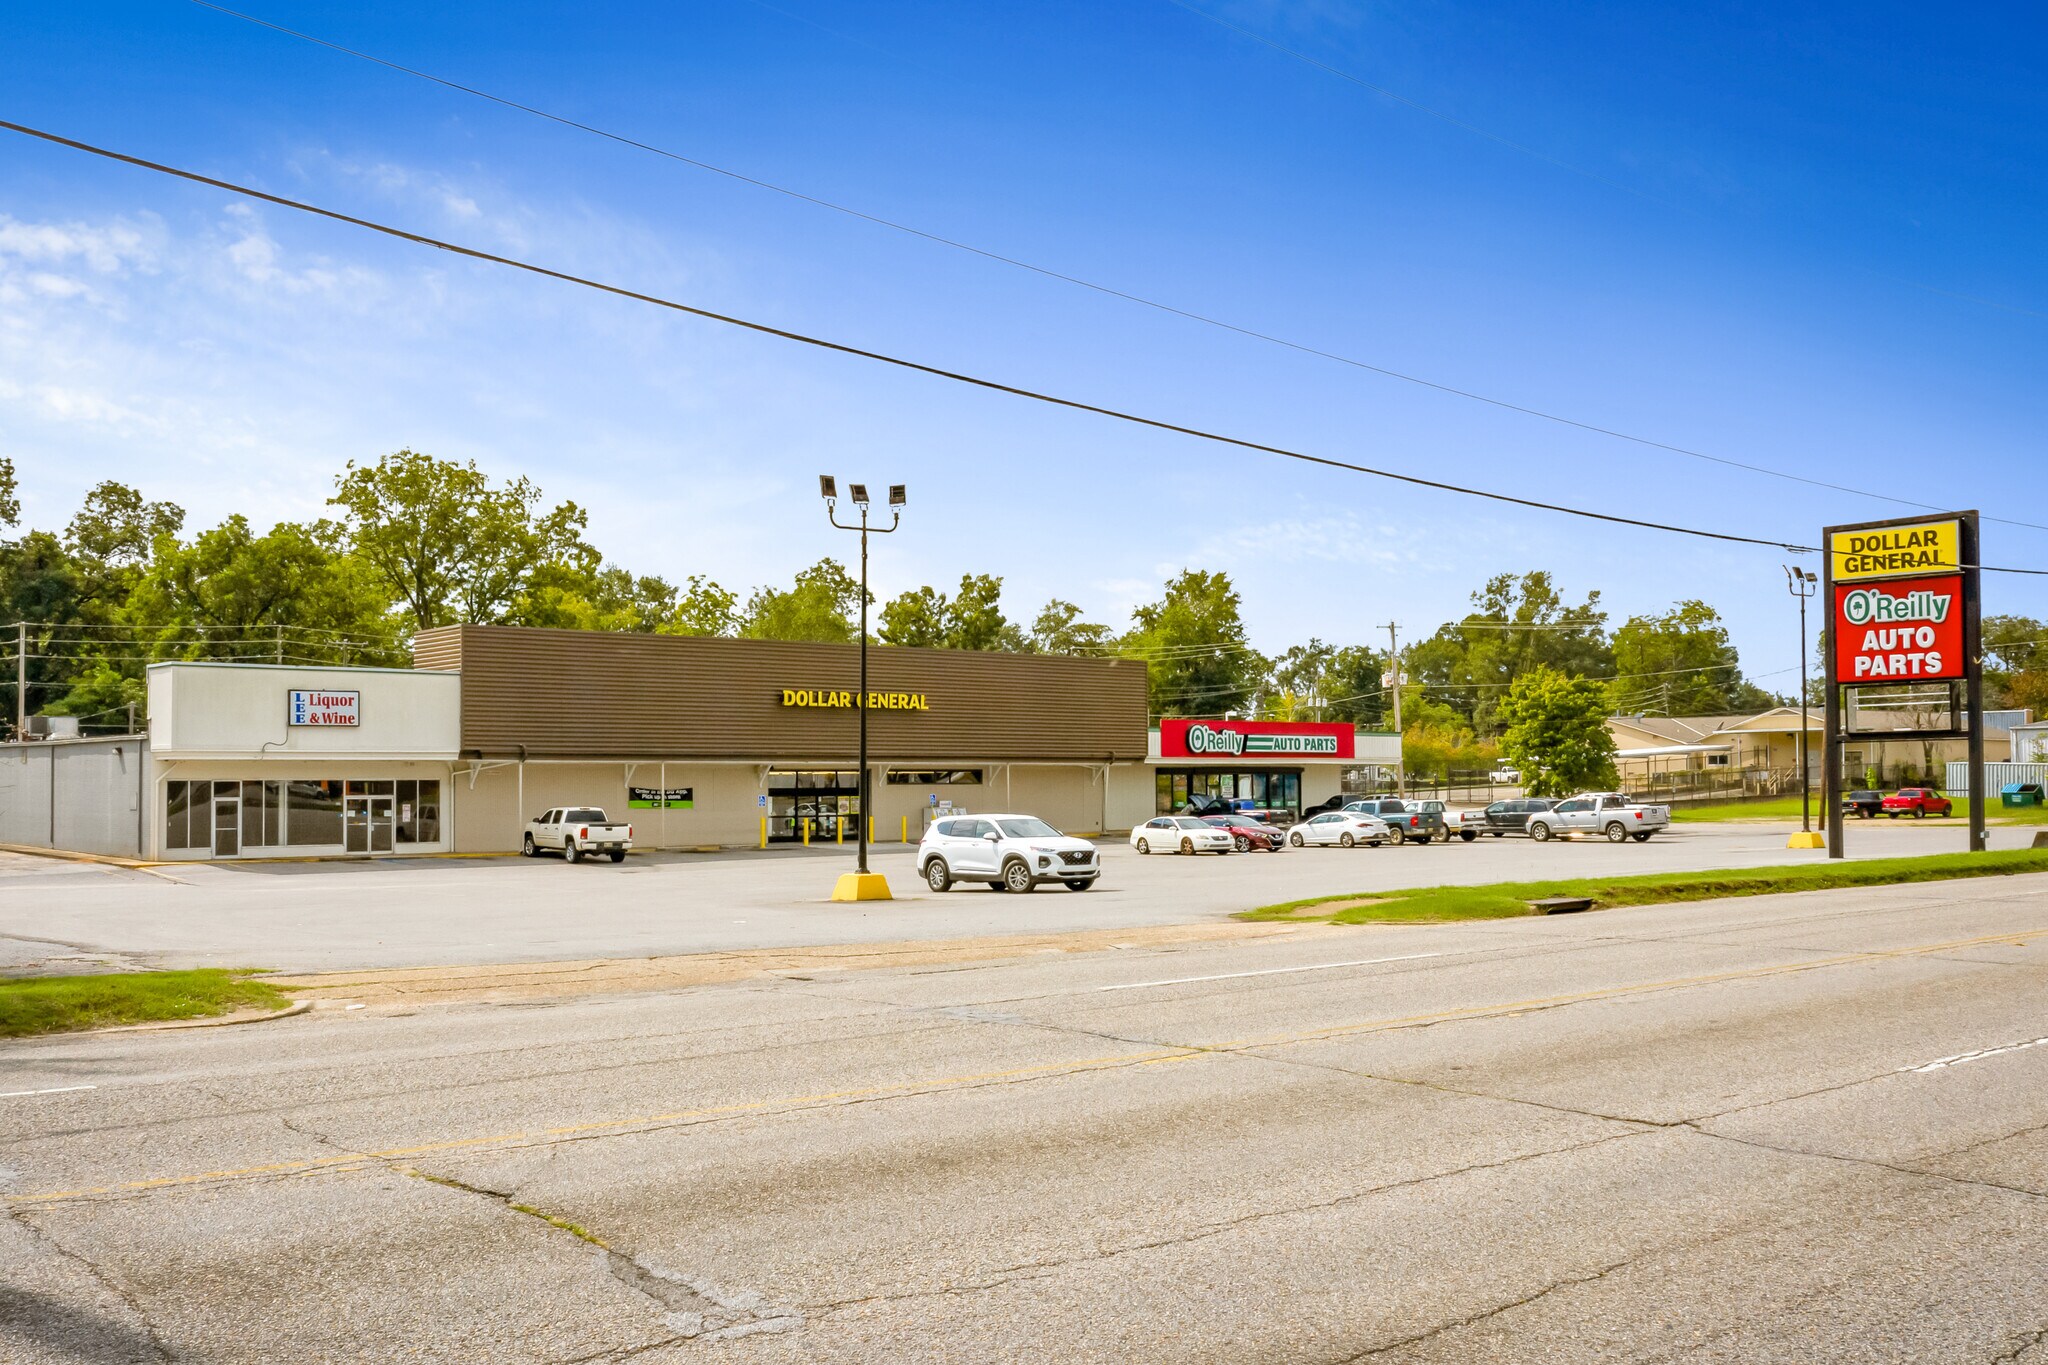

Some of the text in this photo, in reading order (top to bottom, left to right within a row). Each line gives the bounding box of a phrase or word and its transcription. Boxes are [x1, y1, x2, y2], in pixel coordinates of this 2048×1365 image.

[1850, 530, 1938, 554] DOLLAR
[1844, 550, 1945, 573] GENERAL
[1845, 589, 1948, 623] O'Reilly
[1862, 626, 1936, 651] AUTO
[1855, 652, 1942, 677] PARTS
[295, 693, 306, 723] LEE
[309, 693, 355, 709] Liquor
[782, 690, 851, 707] DOLLAR
[309, 711, 356, 724] & Wine
[1190, 726, 1336, 755] O'Reilly AUTO PARTS
